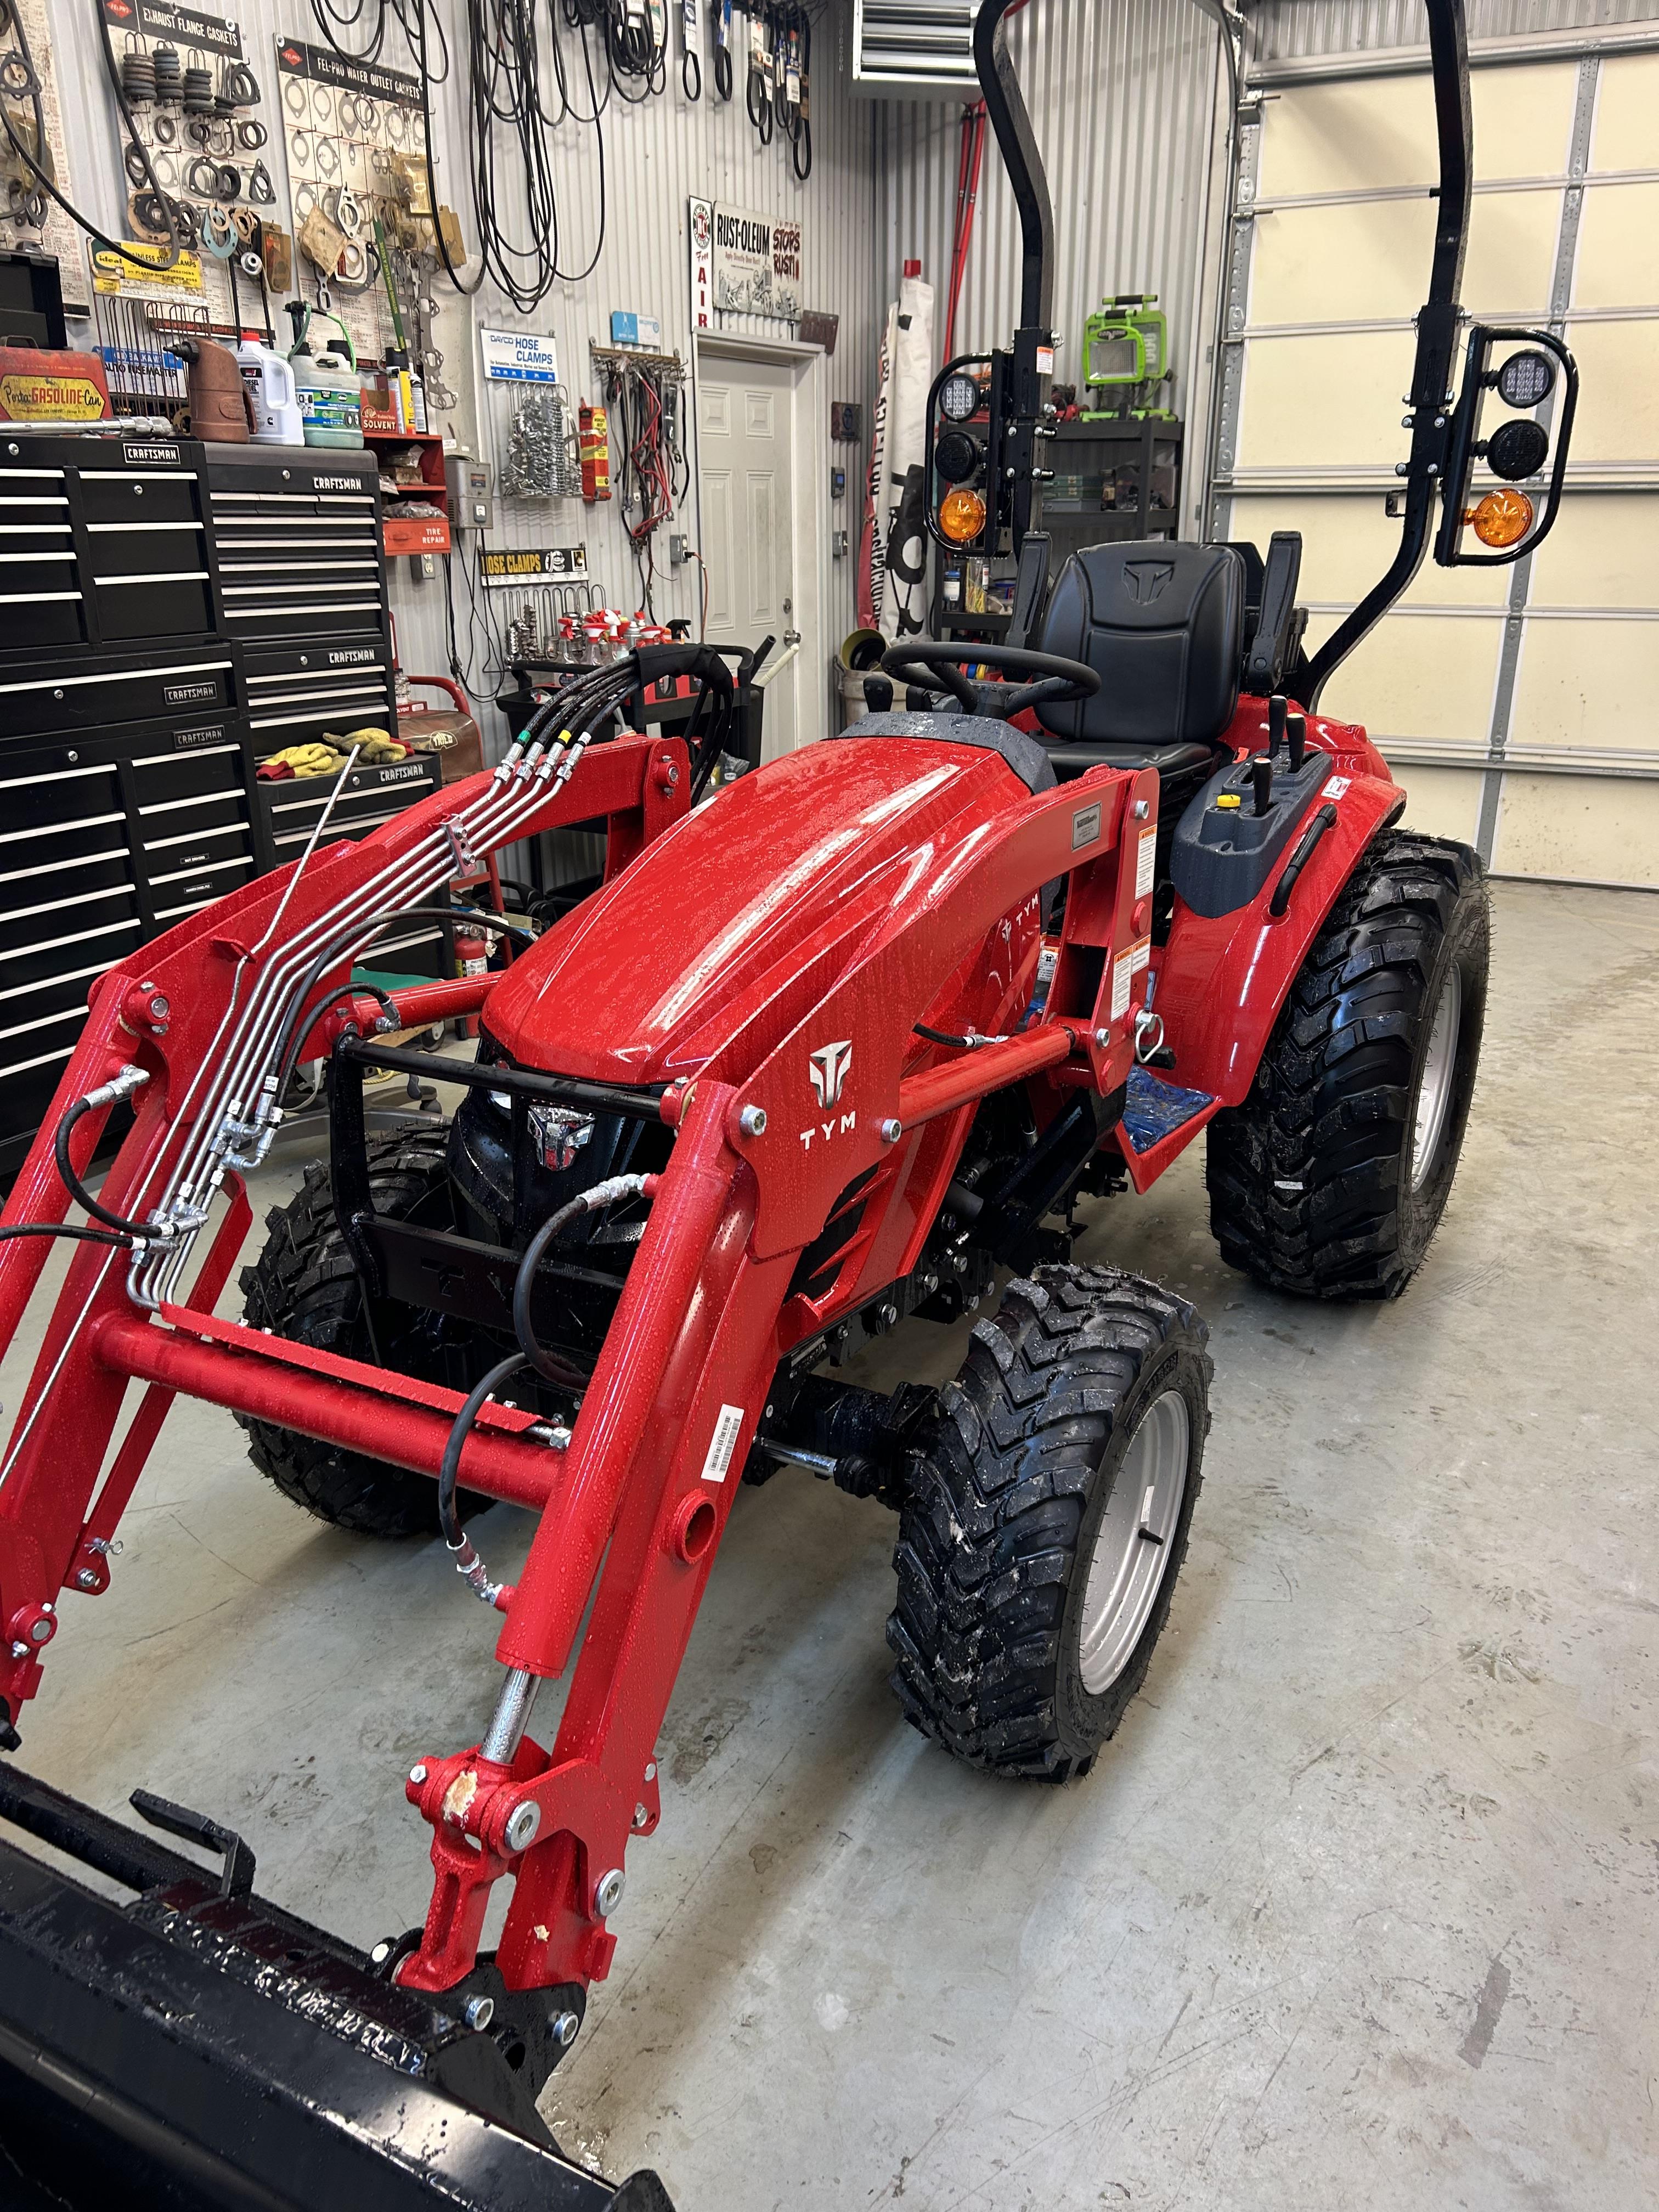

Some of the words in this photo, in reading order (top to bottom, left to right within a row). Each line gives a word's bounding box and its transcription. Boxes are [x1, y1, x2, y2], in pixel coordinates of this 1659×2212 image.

[143, 7, 176, 29] EXHAUST
[178, 17, 205, 37] FLANGE
[207, 26, 238, 47] GASKETS
[317, 57, 345, 77] FEL-PRO
[347, 65, 368, 83] WATER
[370, 75, 393, 91] OUTLET
[395, 82, 420, 99] GASKETS
[717, 213, 770, 256] RUST-OLEUM
[773, 228, 800, 253] STOPS
[99, 255, 122, 264] ideal
[490, 335, 514, 344] DAYCO
[515, 337, 539, 351] HOSE
[516, 351, 552, 365] CLAMPS
[104, 363, 126, 373] AUTO
[31, 387, 82, 404] GASOLINE
[363, 420, 396, 430] SOLVENT
[128, 448, 177, 460] CRAFTSMAN
[313, 476, 362, 490] CRAFTSMAN
[506, 554, 541, 573] CLAMPS
[329, 648, 375, 664] CRAFTSMAN
[168, 686, 213, 701] CRAFTSMAN
[178, 730, 222, 744] CRAFTSMAN
[379, 764, 424, 782] CRAFTSMAN
[1016, 893, 1039, 926] TYM
[800, 1110, 856, 1150] TYM
